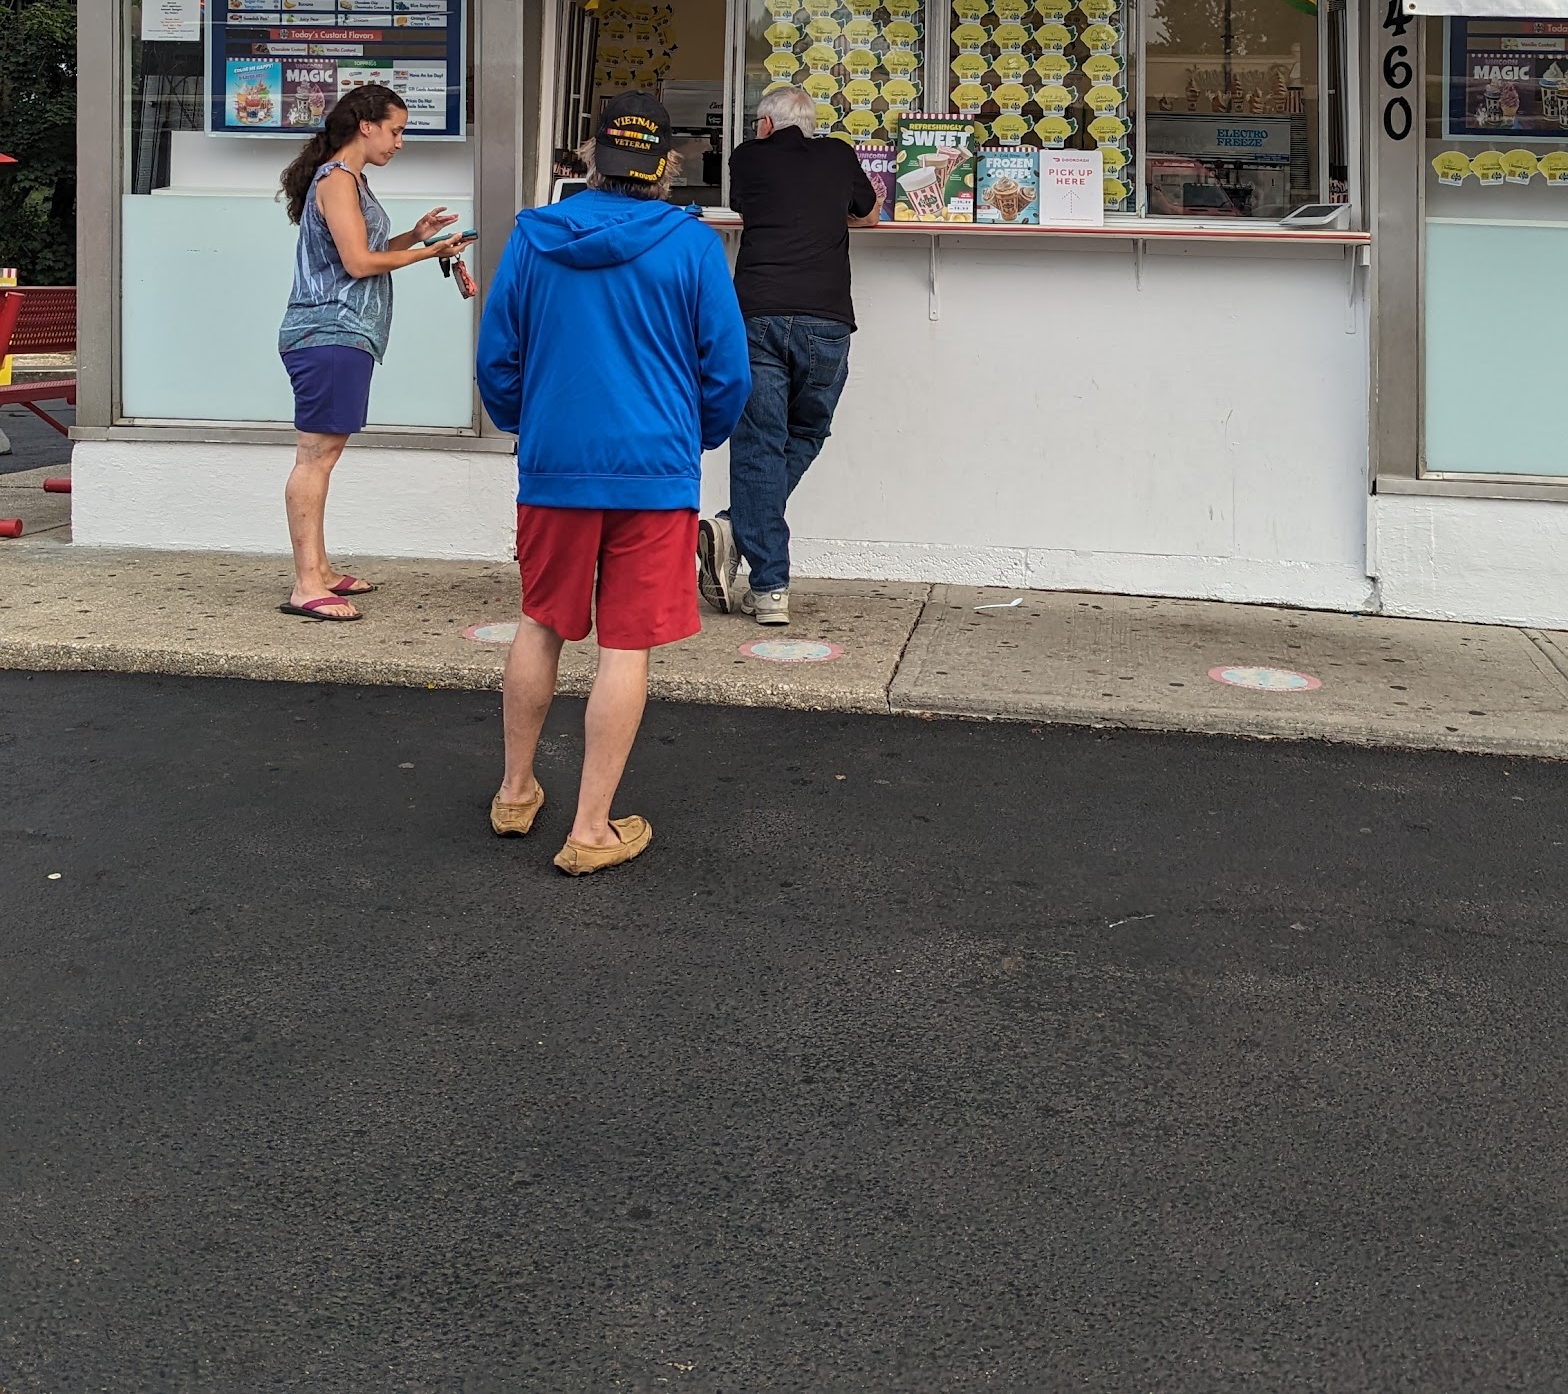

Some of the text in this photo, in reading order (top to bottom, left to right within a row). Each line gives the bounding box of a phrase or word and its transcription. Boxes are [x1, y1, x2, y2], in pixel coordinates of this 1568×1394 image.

[1547, 24, 1568, 33] Toda
[291, 30, 374, 40] Today's Custard Flavors
[286, 69, 334, 83] MAGIC
[1474, 66, 1530, 80] MAGIC
[613, 115, 659, 134] VIETNAM
[909, 123, 964, 131] REFRESHINGLY
[902, 130, 970, 148] SWEET
[1216, 129, 1268, 139] ELECTRO
[614, 137, 652, 150] VETERAN
[1216, 138, 1263, 147] FREEZE
[860, 159, 897, 173] AGIC
[986, 158, 1034, 168] FROZEN
[988, 168, 1031, 179] COFFEE
